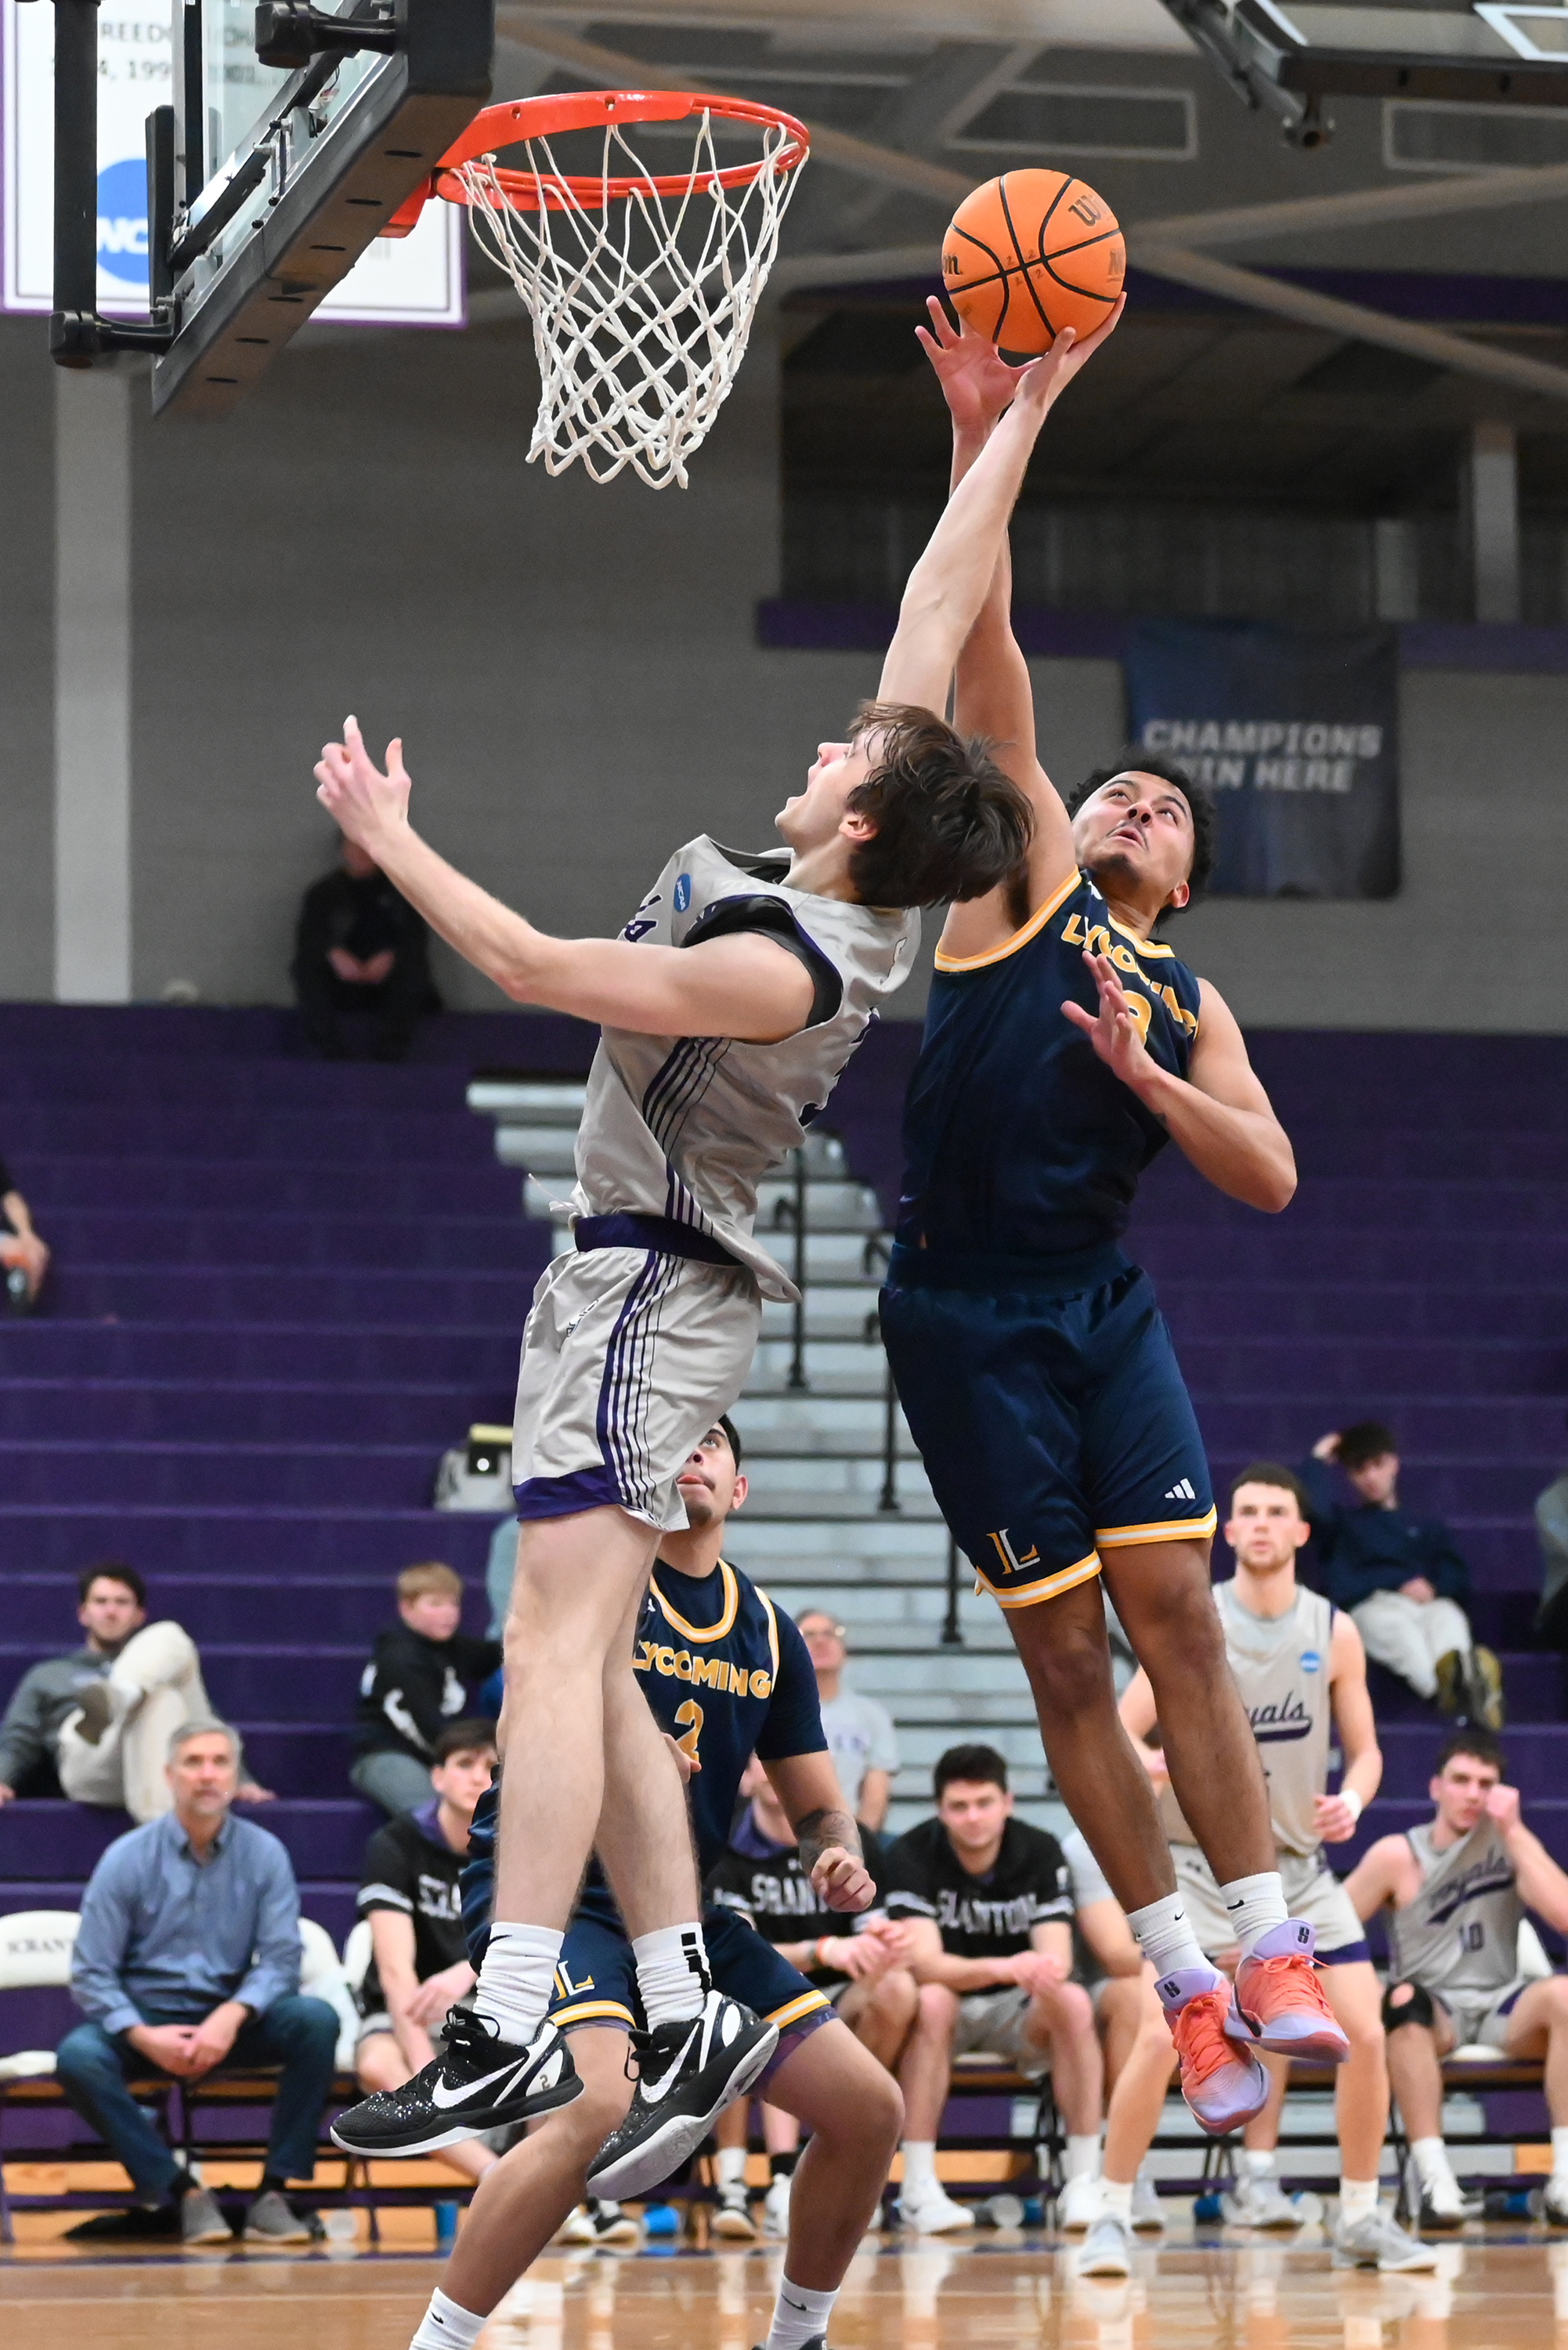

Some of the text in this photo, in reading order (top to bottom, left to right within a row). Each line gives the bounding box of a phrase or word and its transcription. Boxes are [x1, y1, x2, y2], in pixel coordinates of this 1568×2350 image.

[1143, 719, 1383, 758] CHAMPIONS
[1255, 757, 1355, 793] HERE
[1060, 913, 1198, 1036] LYCONG
[985, 1528, 1041, 1575] L
[632, 1640, 771, 1699] LYCOMING
